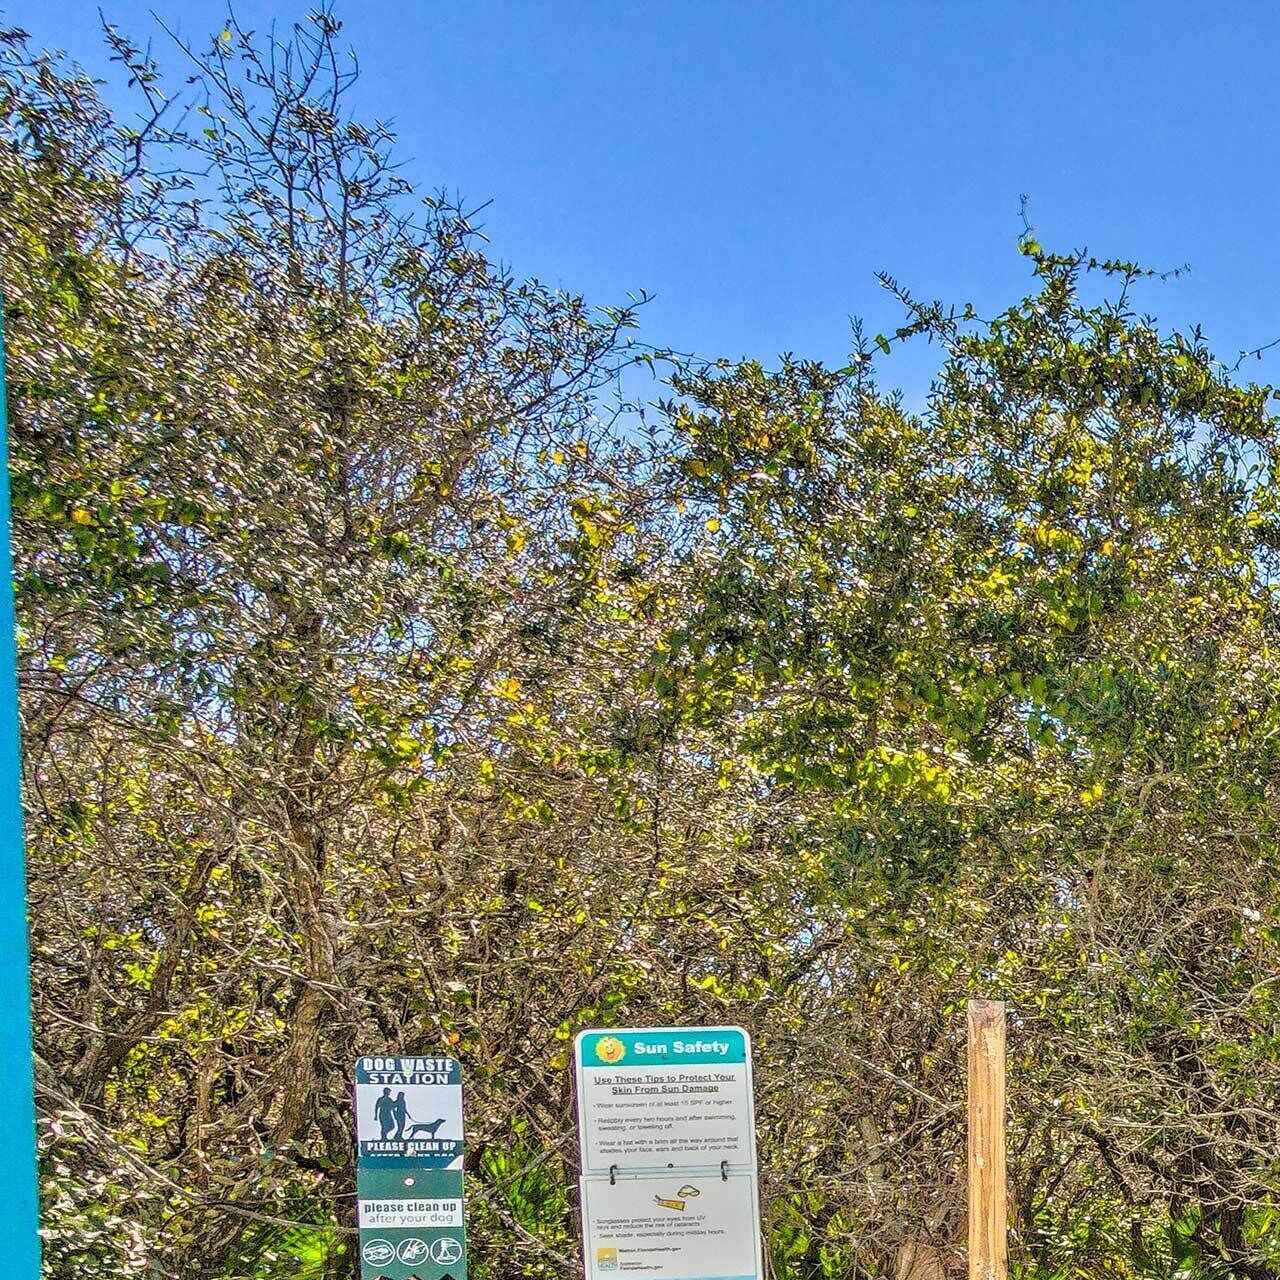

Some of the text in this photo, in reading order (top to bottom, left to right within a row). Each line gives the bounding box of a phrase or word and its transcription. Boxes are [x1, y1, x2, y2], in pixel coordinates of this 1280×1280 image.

[634, 1040, 730, 1056] Sun Safety
[363, 1058, 453, 1072] DOG WASTE
[594, 1073, 735, 1084] Use These Tips to Protect Your
[612, 1084, 719, 1095] Skin From Sun Damage
[367, 1141, 456, 1151] PLEASE CLEAN UP
[364, 1202, 457, 1213] please clean up
[369, 1213, 454, 1225] after your dog
